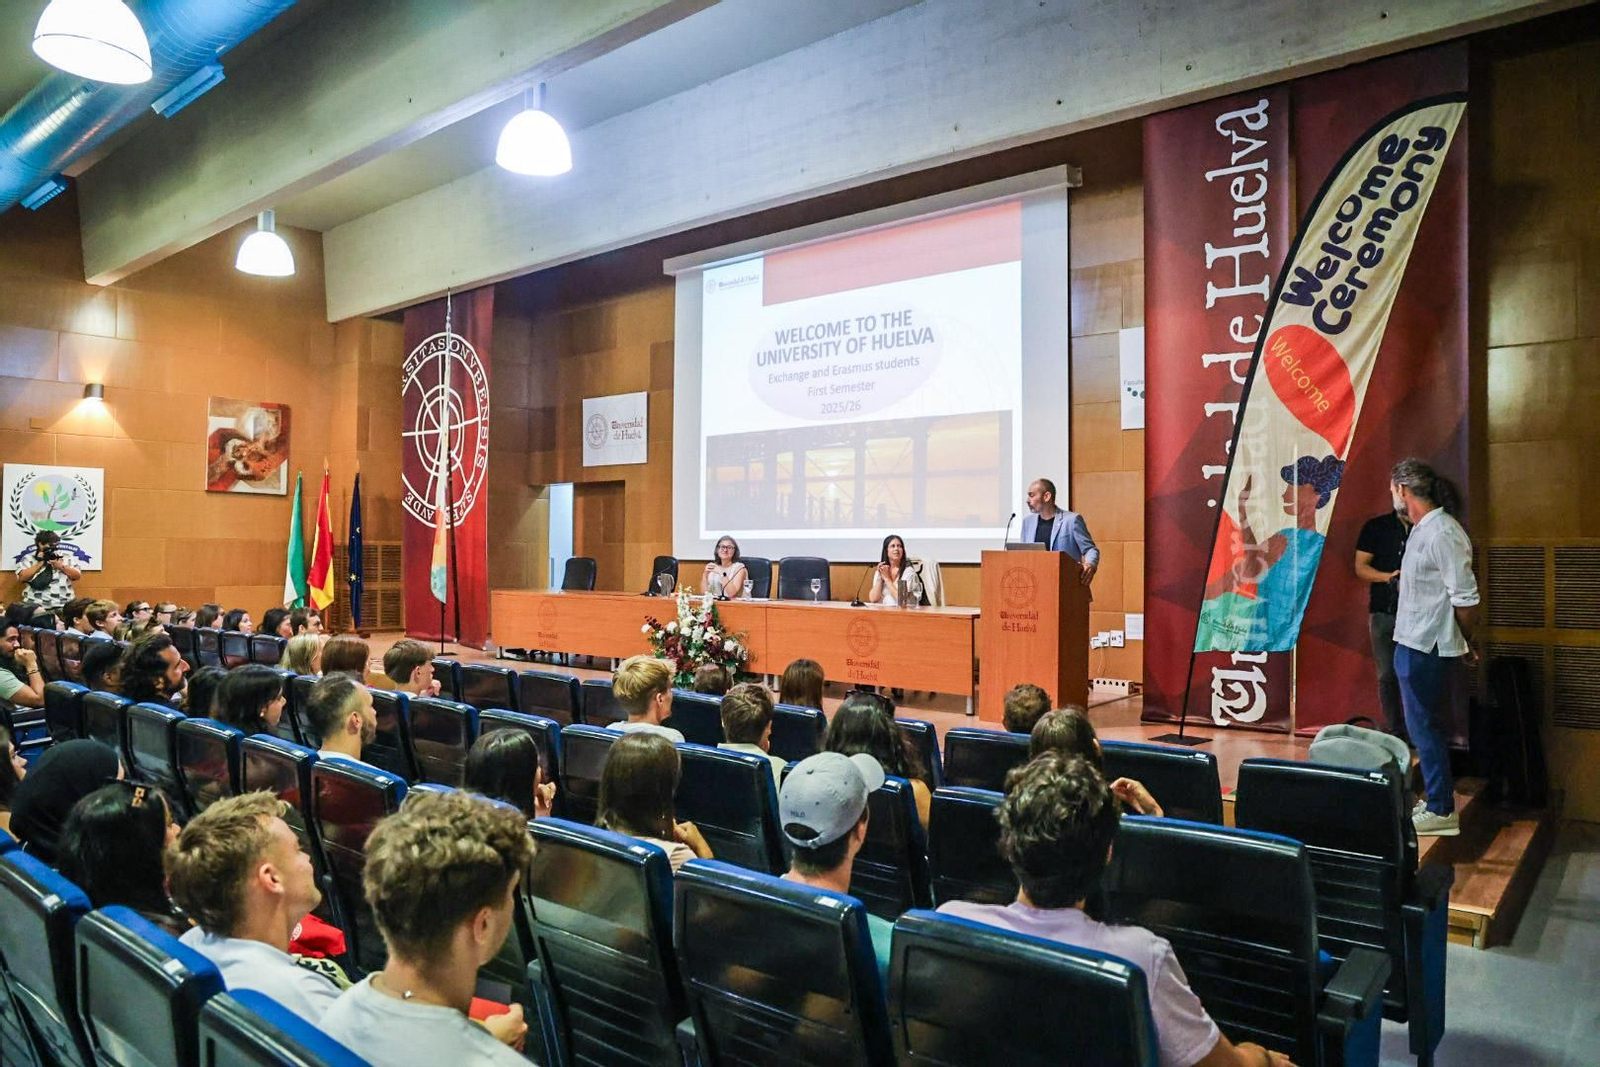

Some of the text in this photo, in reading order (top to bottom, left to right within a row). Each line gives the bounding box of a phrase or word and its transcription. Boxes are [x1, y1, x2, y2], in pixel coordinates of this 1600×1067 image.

[1205, 98, 1269, 309] Huelva
[1280, 133, 1410, 307] Welcome
[1312, 126, 1447, 335] Ceremony
[756, 326, 935, 367] UNIVERSITY OF HUELVA
[775, 309, 913, 346] WELCOME TO THE
[1202, 314, 1264, 385] de
[768, 355, 920, 384] Exchange and Erasmus students
[807, 380, 876, 397] First Semester
[1270, 336, 1330, 413] Welcome
[821, 400, 862, 414] 2025/26
